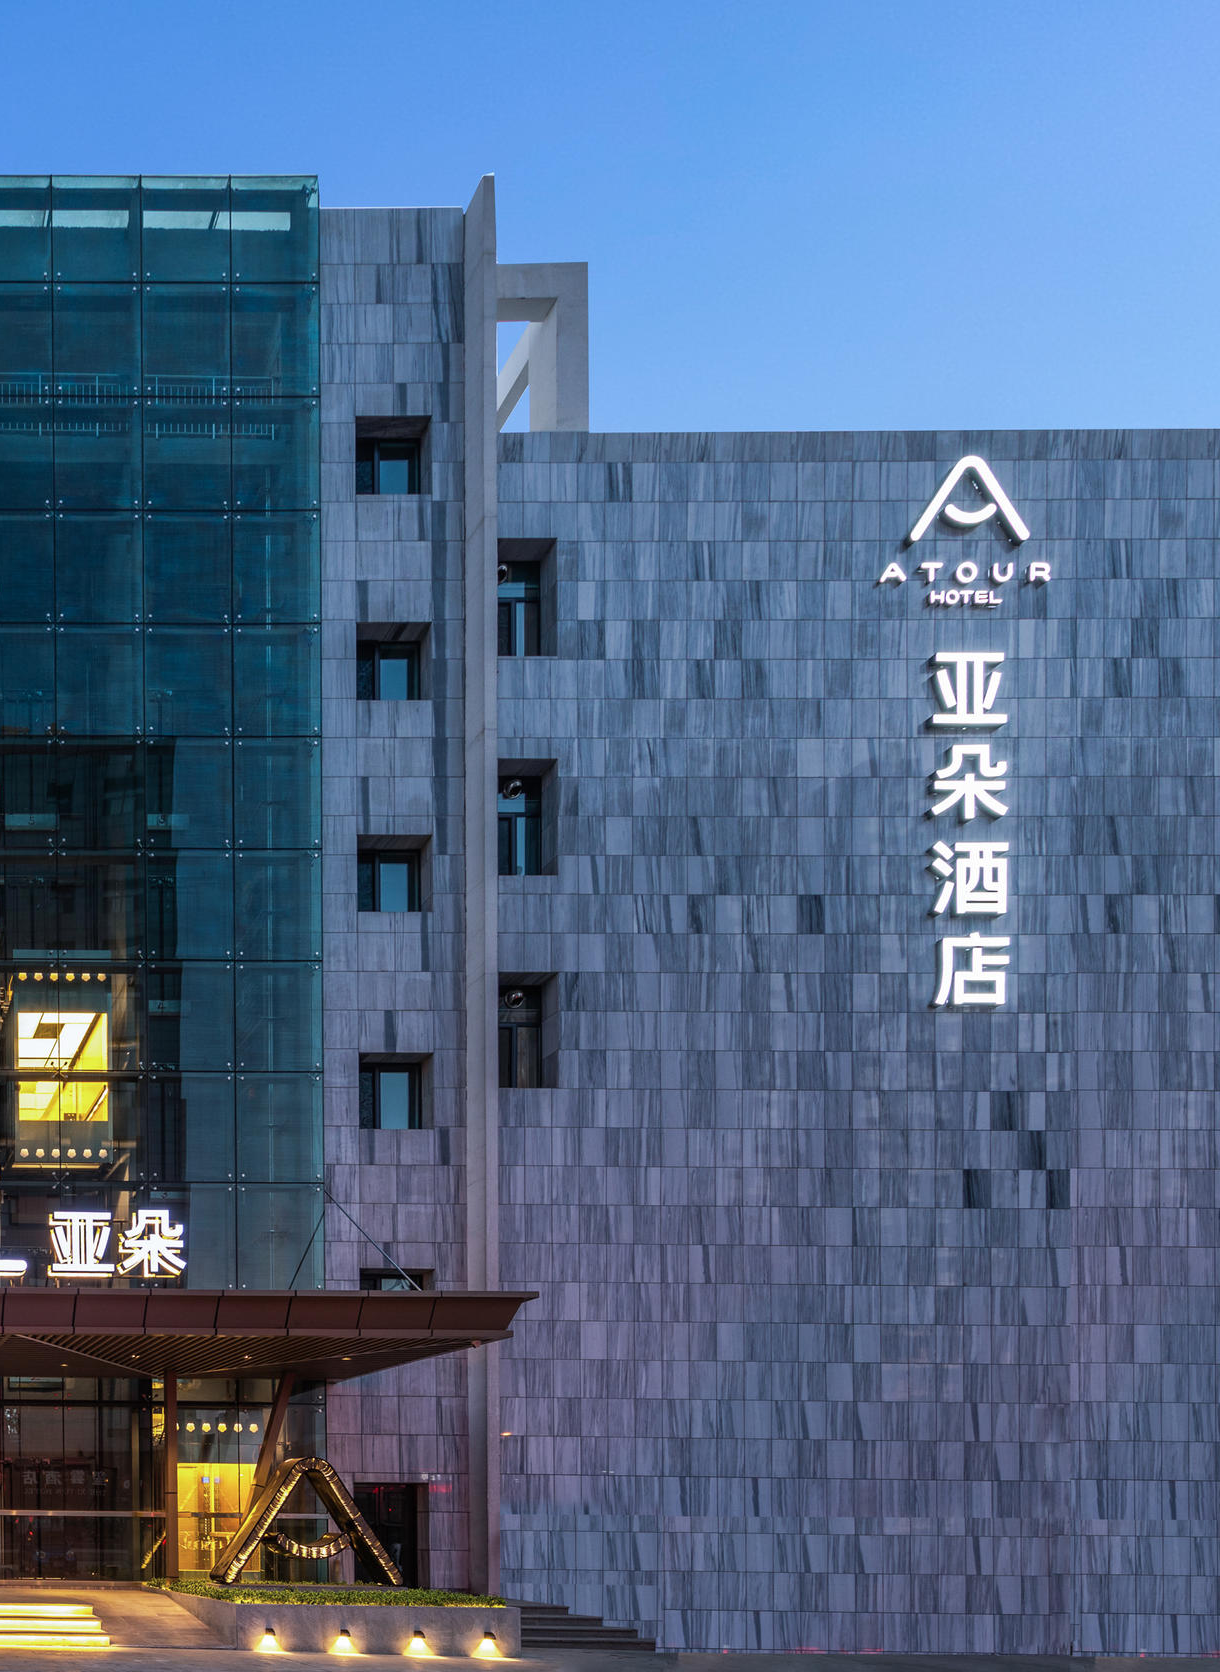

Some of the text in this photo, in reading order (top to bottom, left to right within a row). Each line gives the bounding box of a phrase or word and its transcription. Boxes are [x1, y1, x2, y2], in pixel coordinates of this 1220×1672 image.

[880, 562, 1051, 583] ATOUR
[930, 589, 1003, 605] HOTEL
[932, 652, 1010, 1005] 亚朵酒店
[48, 1209, 188, 1277] 亚朵
